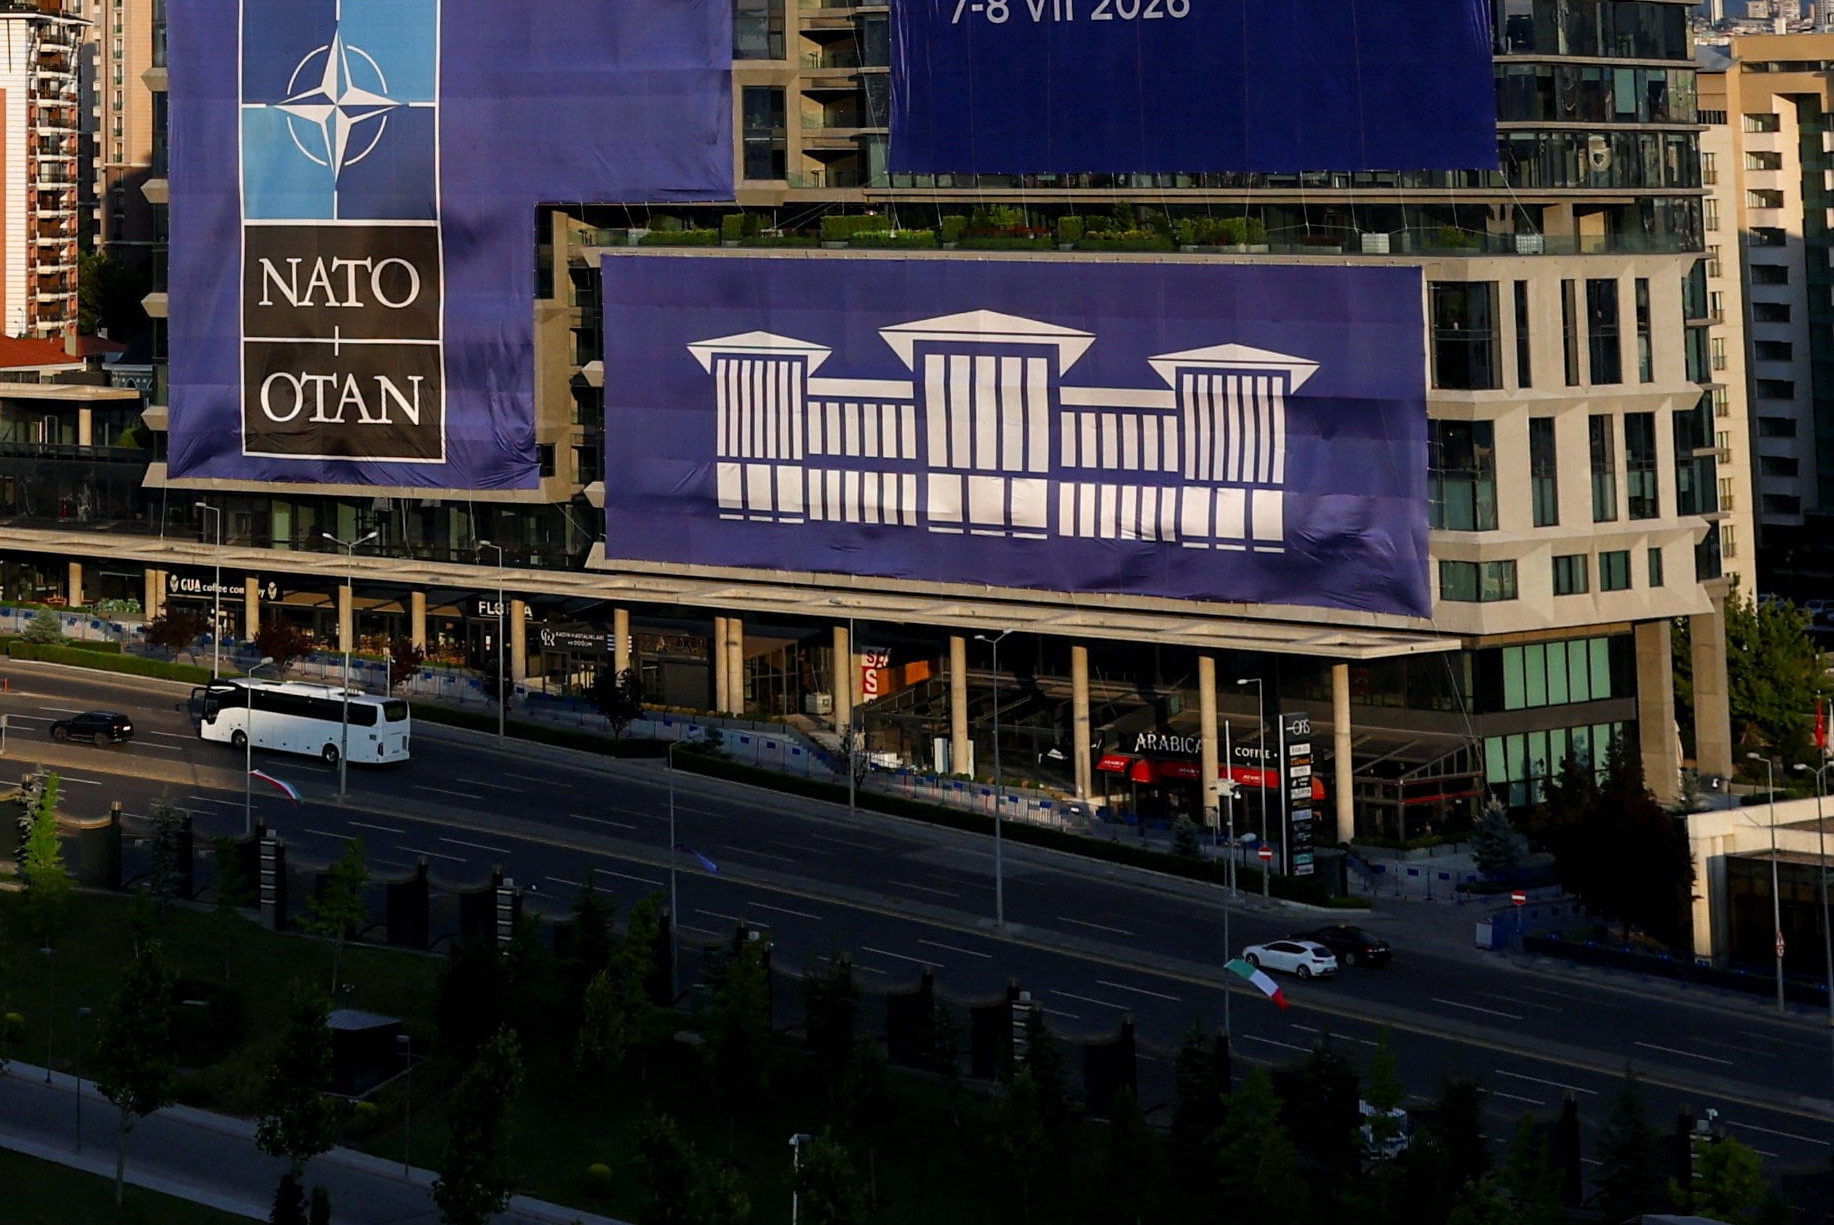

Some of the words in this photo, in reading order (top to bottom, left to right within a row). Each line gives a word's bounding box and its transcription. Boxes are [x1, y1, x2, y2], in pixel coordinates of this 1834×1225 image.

[258, 257, 421, 309] NATO
[260, 372, 424, 426] OTAN
[1134, 732, 1202, 754] ARABICA
